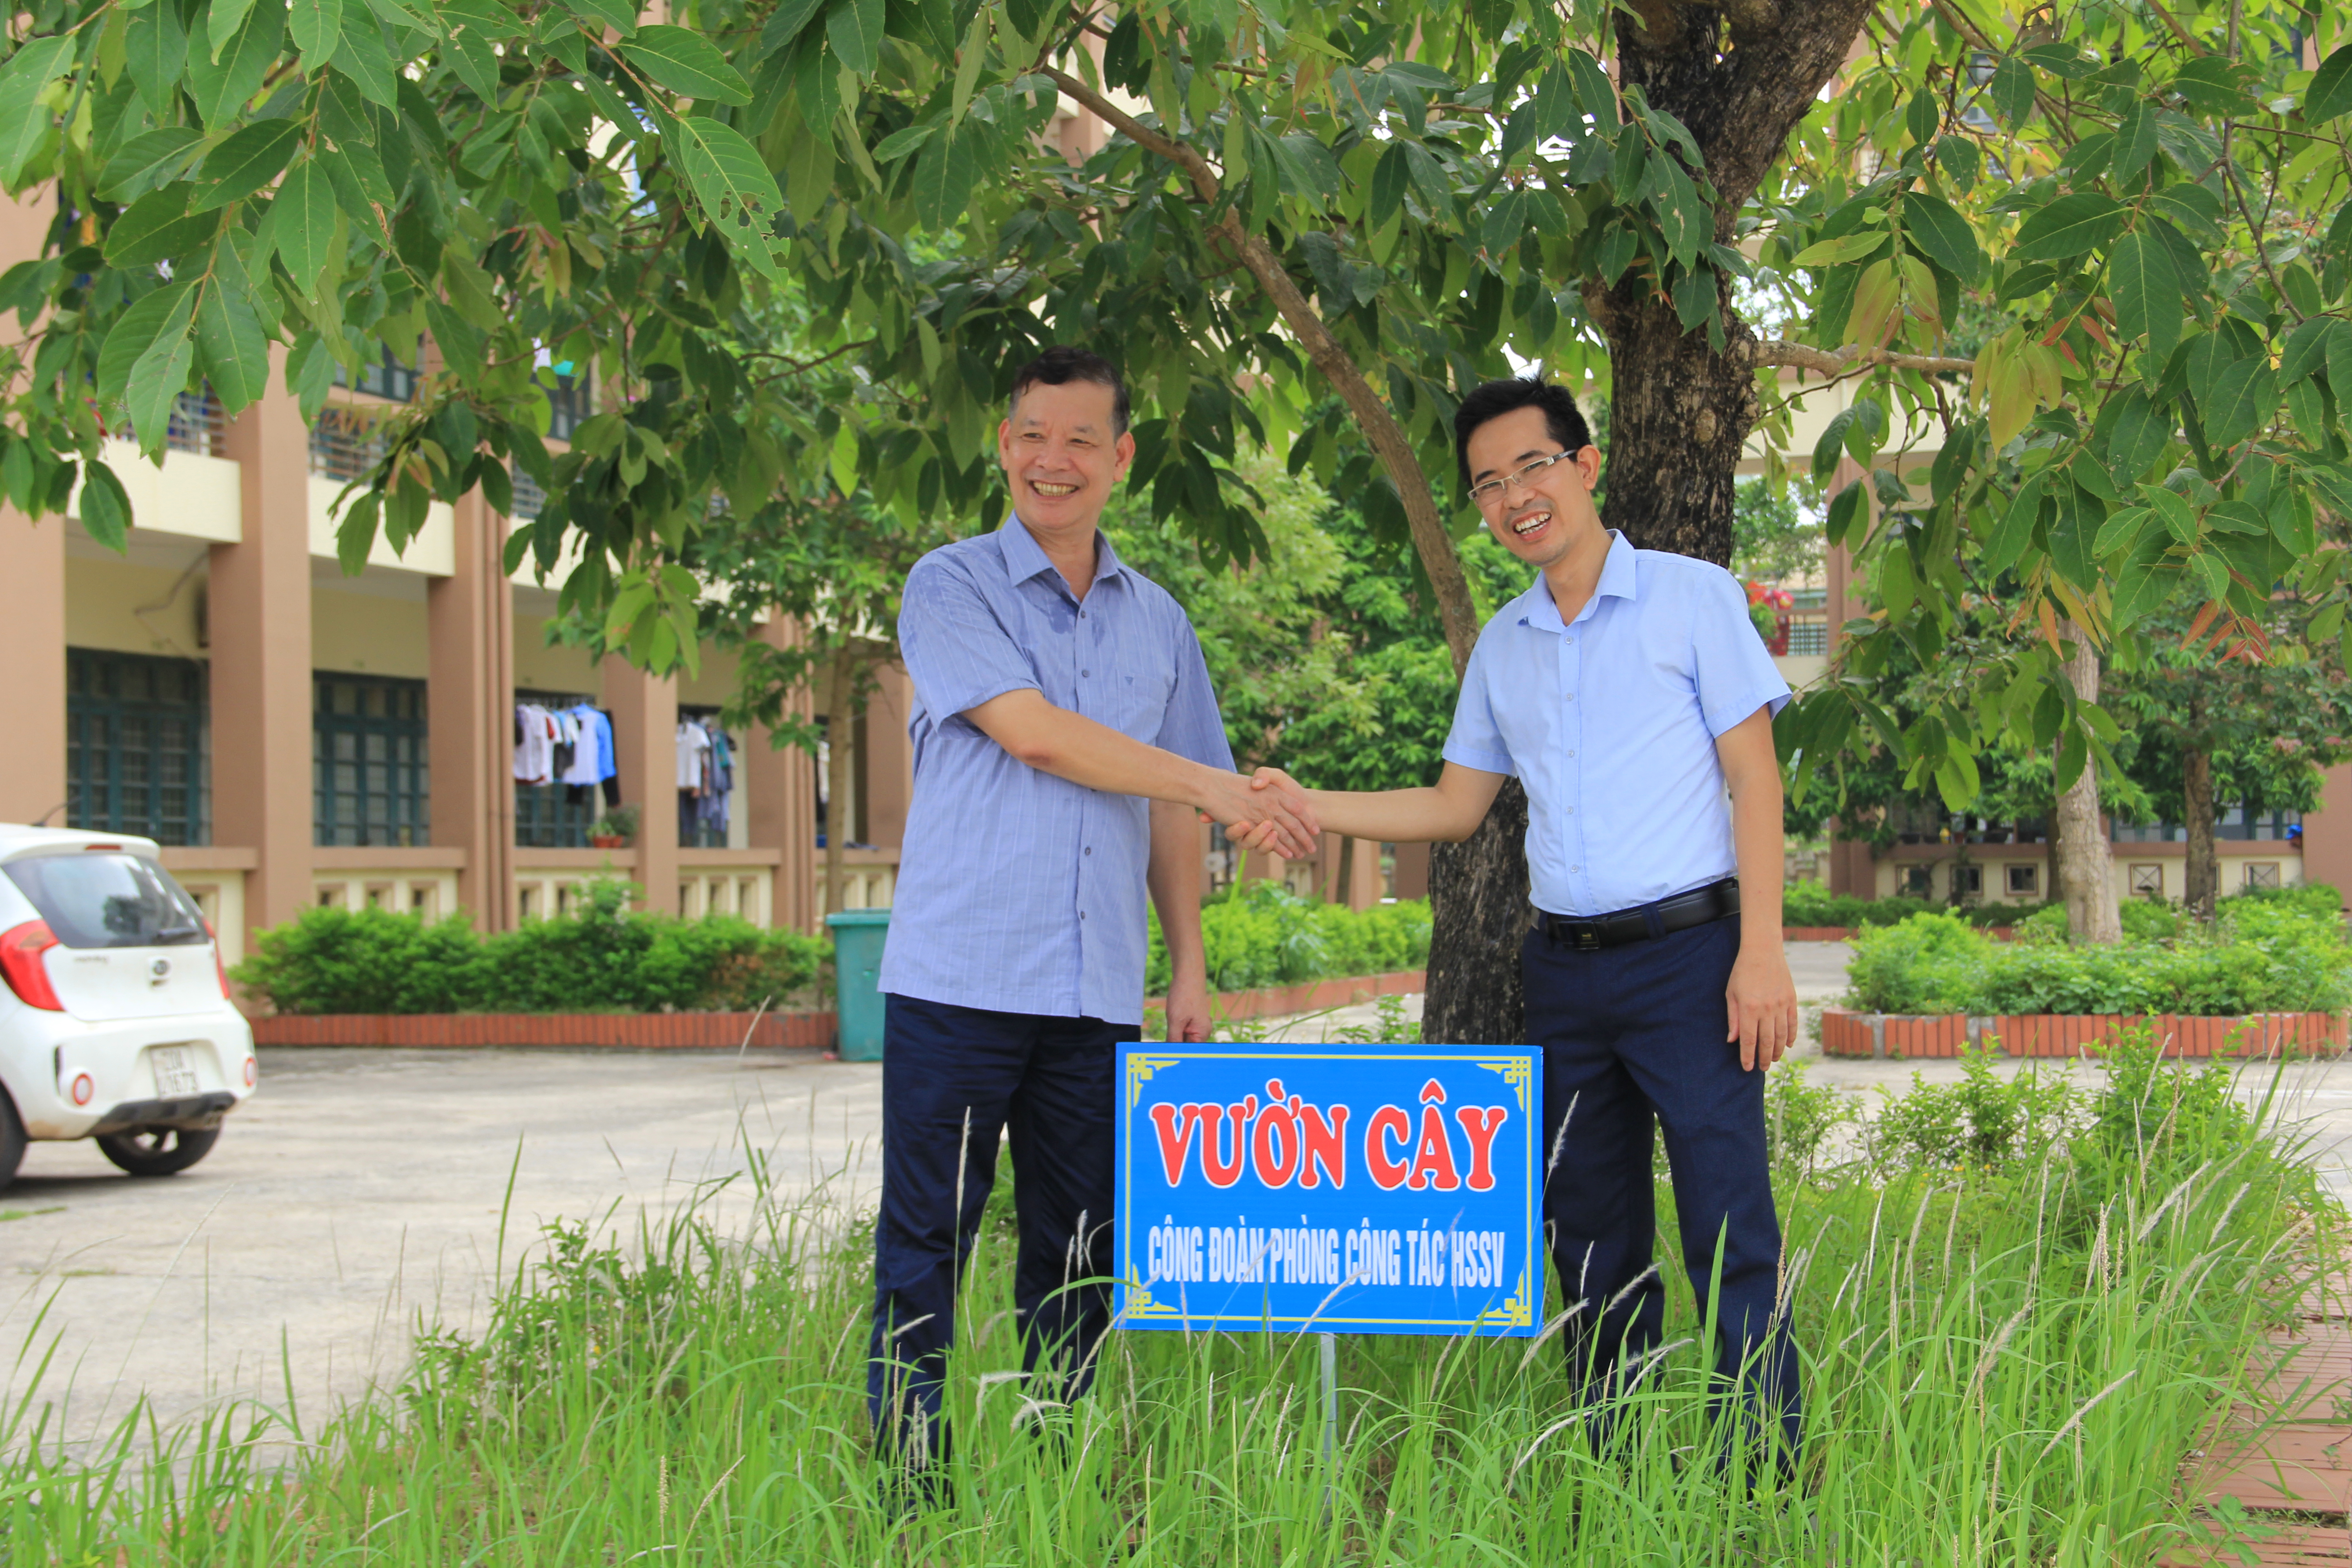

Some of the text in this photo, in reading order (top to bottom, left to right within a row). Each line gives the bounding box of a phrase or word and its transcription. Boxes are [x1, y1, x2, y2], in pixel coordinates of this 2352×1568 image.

[1149, 1078, 1508, 1192] VƯỜN CÂY
[1148, 1214, 1505, 1288] CÔNG ĐOÀN PHÒNG CÔNG TÁC HSSV
